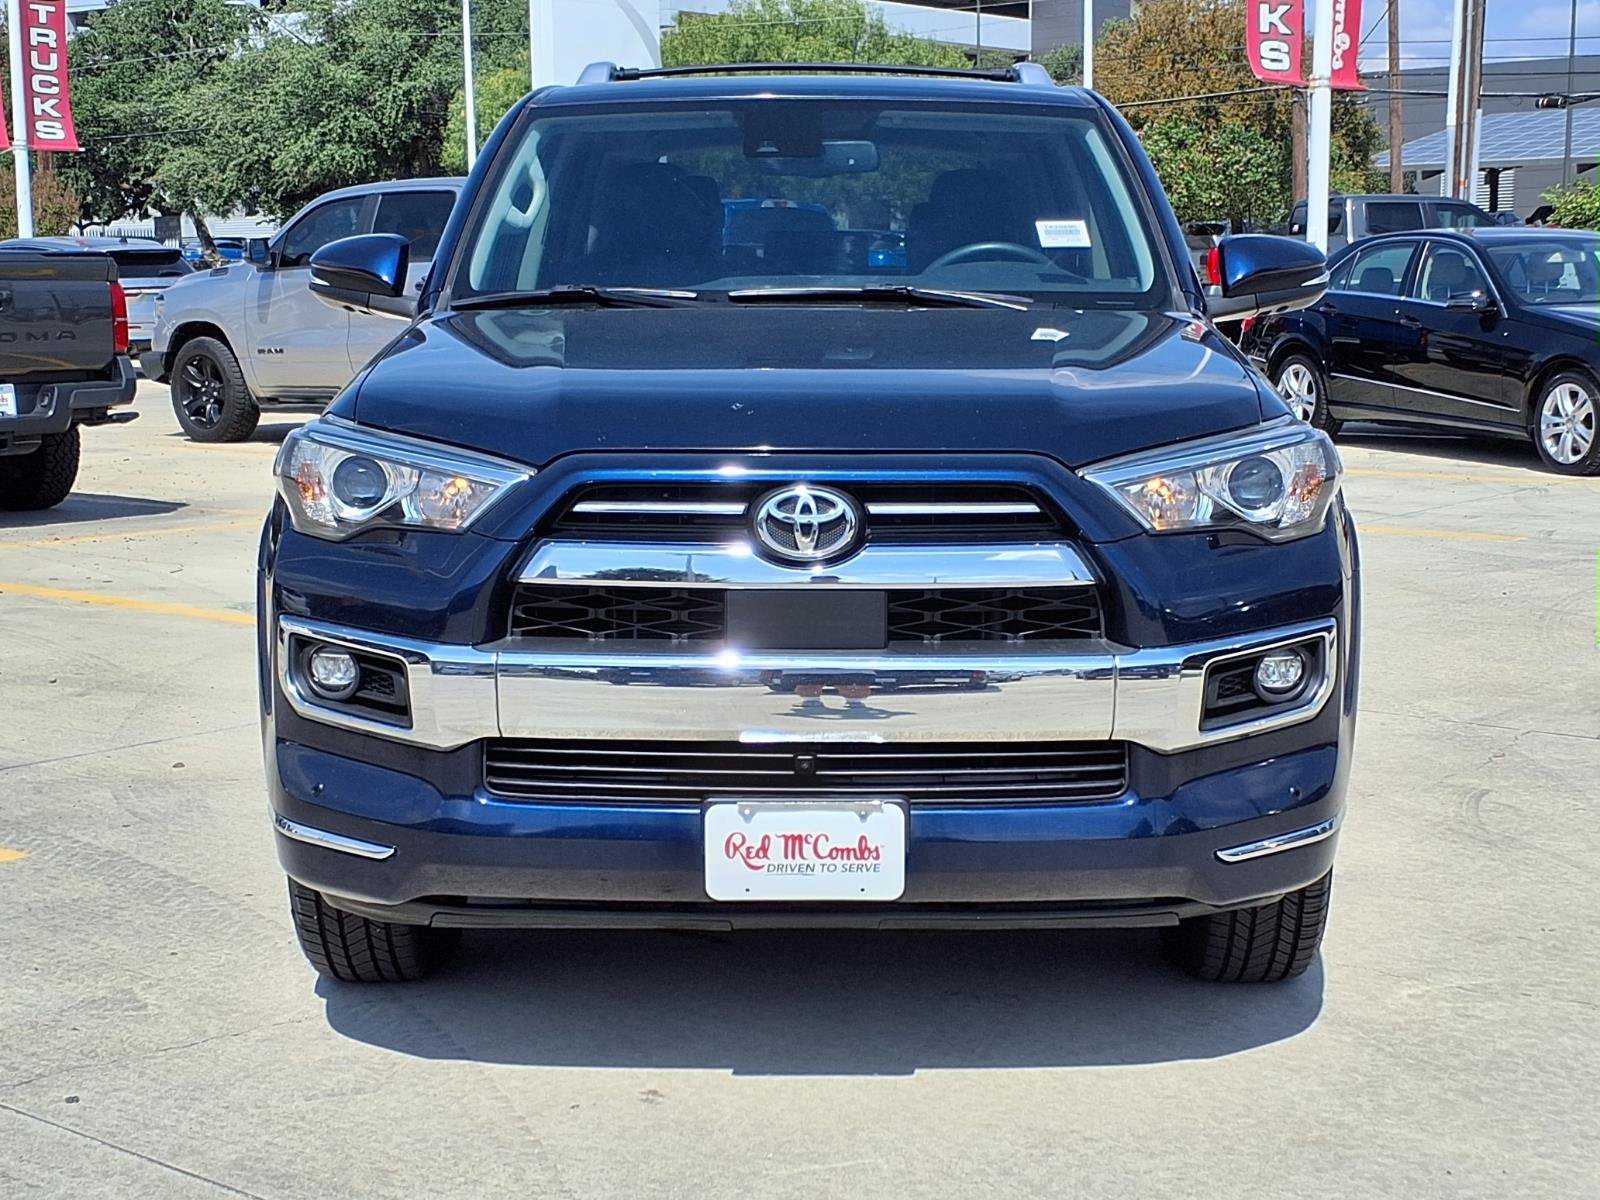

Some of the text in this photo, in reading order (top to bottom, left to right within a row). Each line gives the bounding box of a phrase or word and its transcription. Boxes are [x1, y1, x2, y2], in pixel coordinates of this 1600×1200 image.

[29, 3, 65, 140] TRUCKS
[257, 347, 284, 355] RAM
[776, 833, 881, 861] McCombs
[766, 863, 881, 873] DRIVEN TO SERVE
